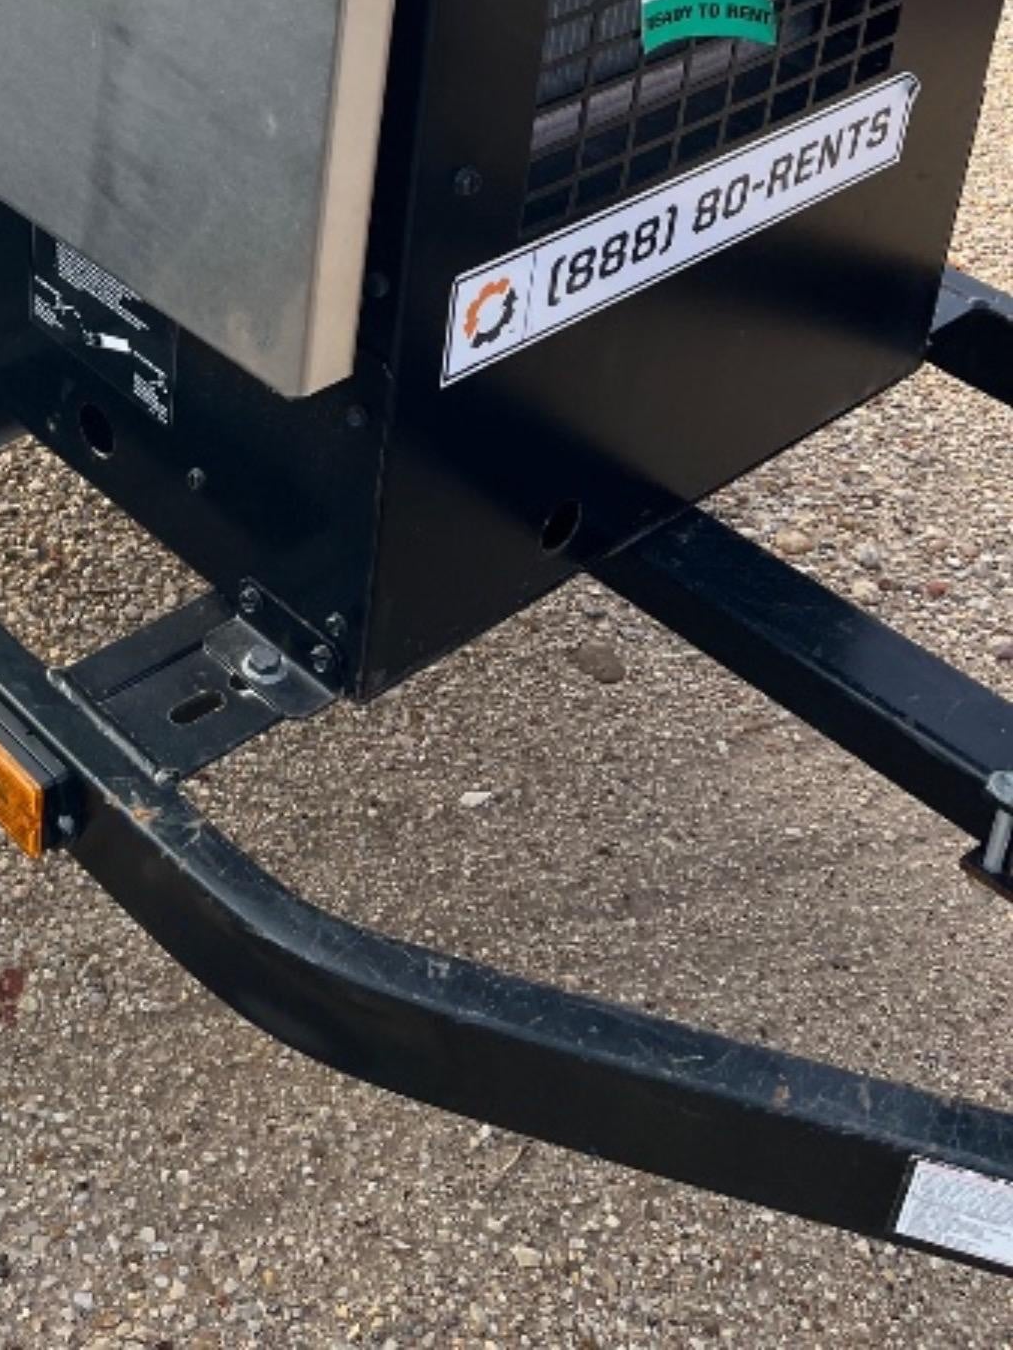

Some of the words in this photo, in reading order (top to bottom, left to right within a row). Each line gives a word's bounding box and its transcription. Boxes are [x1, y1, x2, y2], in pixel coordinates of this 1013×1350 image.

[698, 2, 720, 19] TO
[726, 3, 771, 25] RENT
[548, 203, 678, 307] (888)
[691, 106, 892, 235] 80-RENTS
